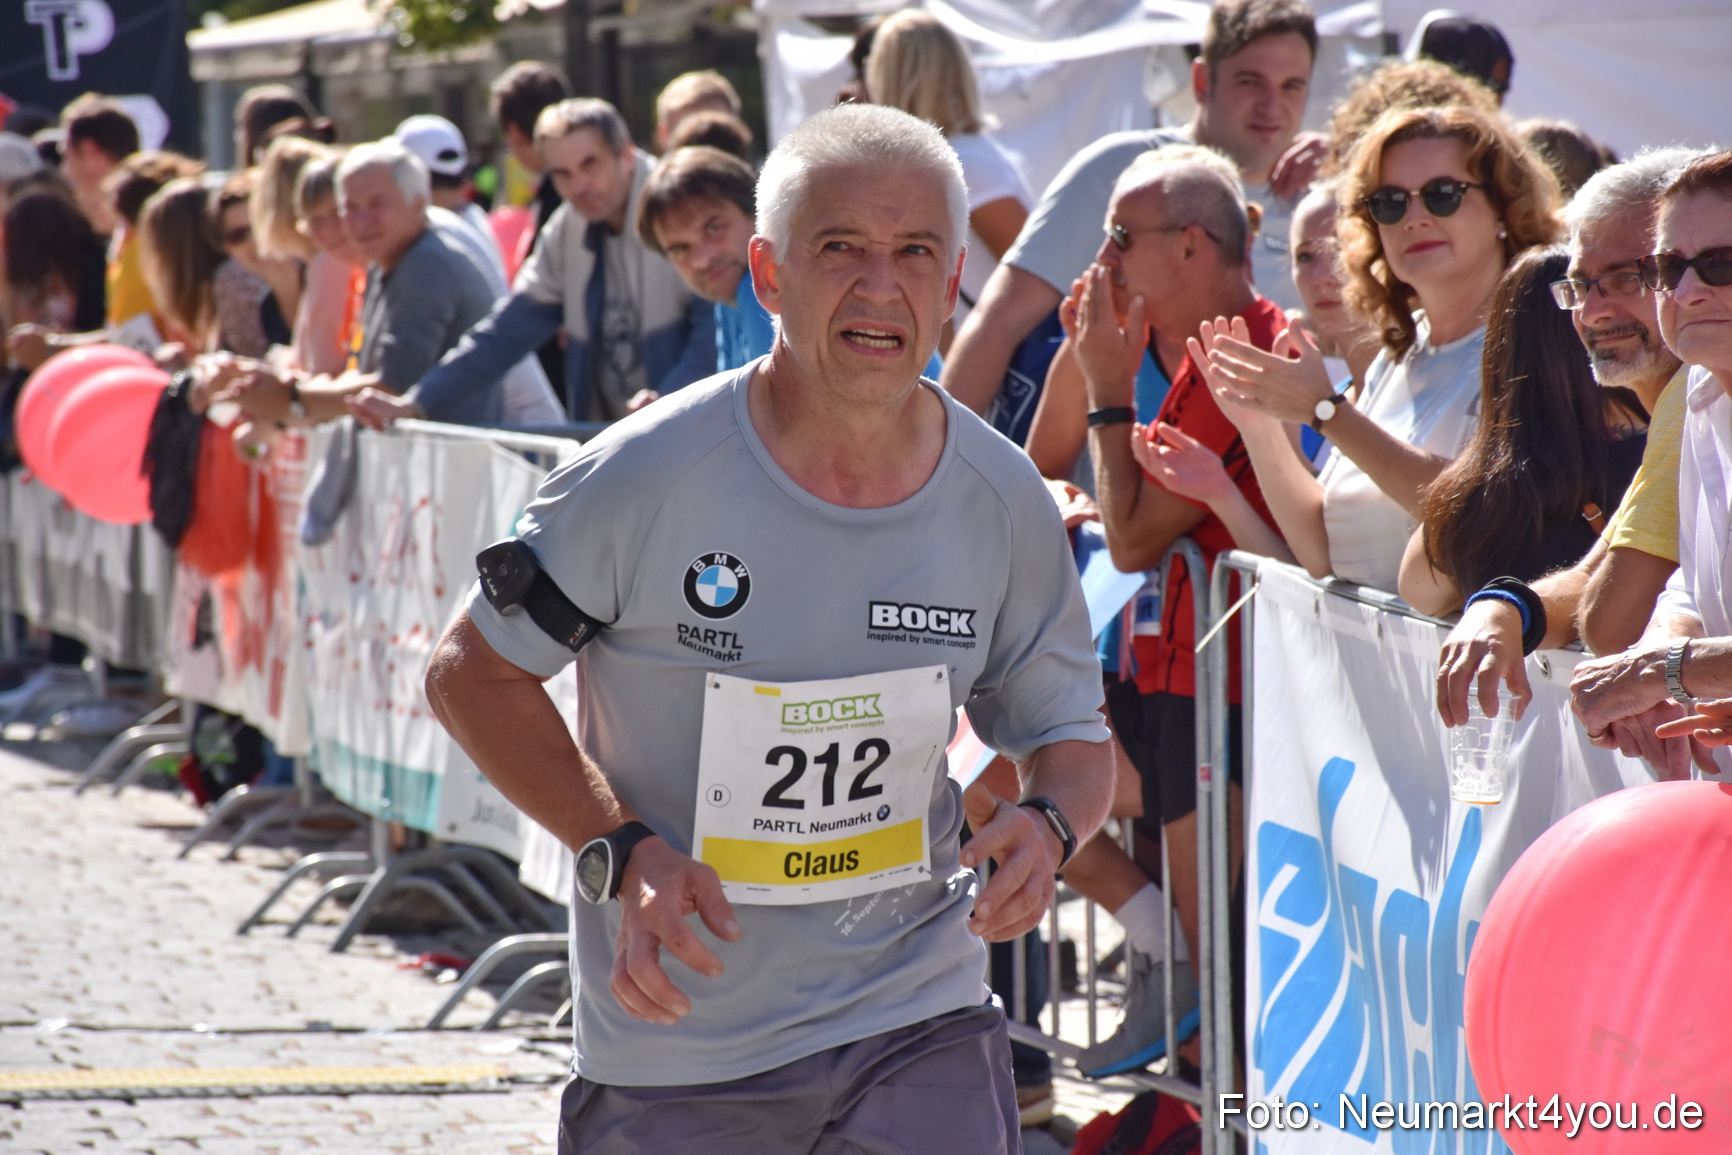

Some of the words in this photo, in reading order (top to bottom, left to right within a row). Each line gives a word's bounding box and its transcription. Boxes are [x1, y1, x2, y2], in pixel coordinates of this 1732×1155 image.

[692, 554, 748, 578] BMW
[868, 600, 977, 638] BOCK
[677, 623, 744, 650] PARTL
[677, 634, 743, 662] Neumarkt
[867, 631, 906, 643] inspired
[909, 634, 920, 645] by
[922, 636, 946, 647] smart
[782, 694, 883, 725] BOCK
[780, 726, 813, 736] inspired
[815, 724, 824, 734] by
[826, 722, 849, 732] smart
[850, 719, 885, 730] concepts
[762, 737, 891, 810] 212
[713, 789, 723, 802] D
[753, 818, 806, 834] PARTL
[809, 811, 873, 834] Neumarkt
[784, 849, 860, 879] Claus
[840, 921, 855, 937] 16.
